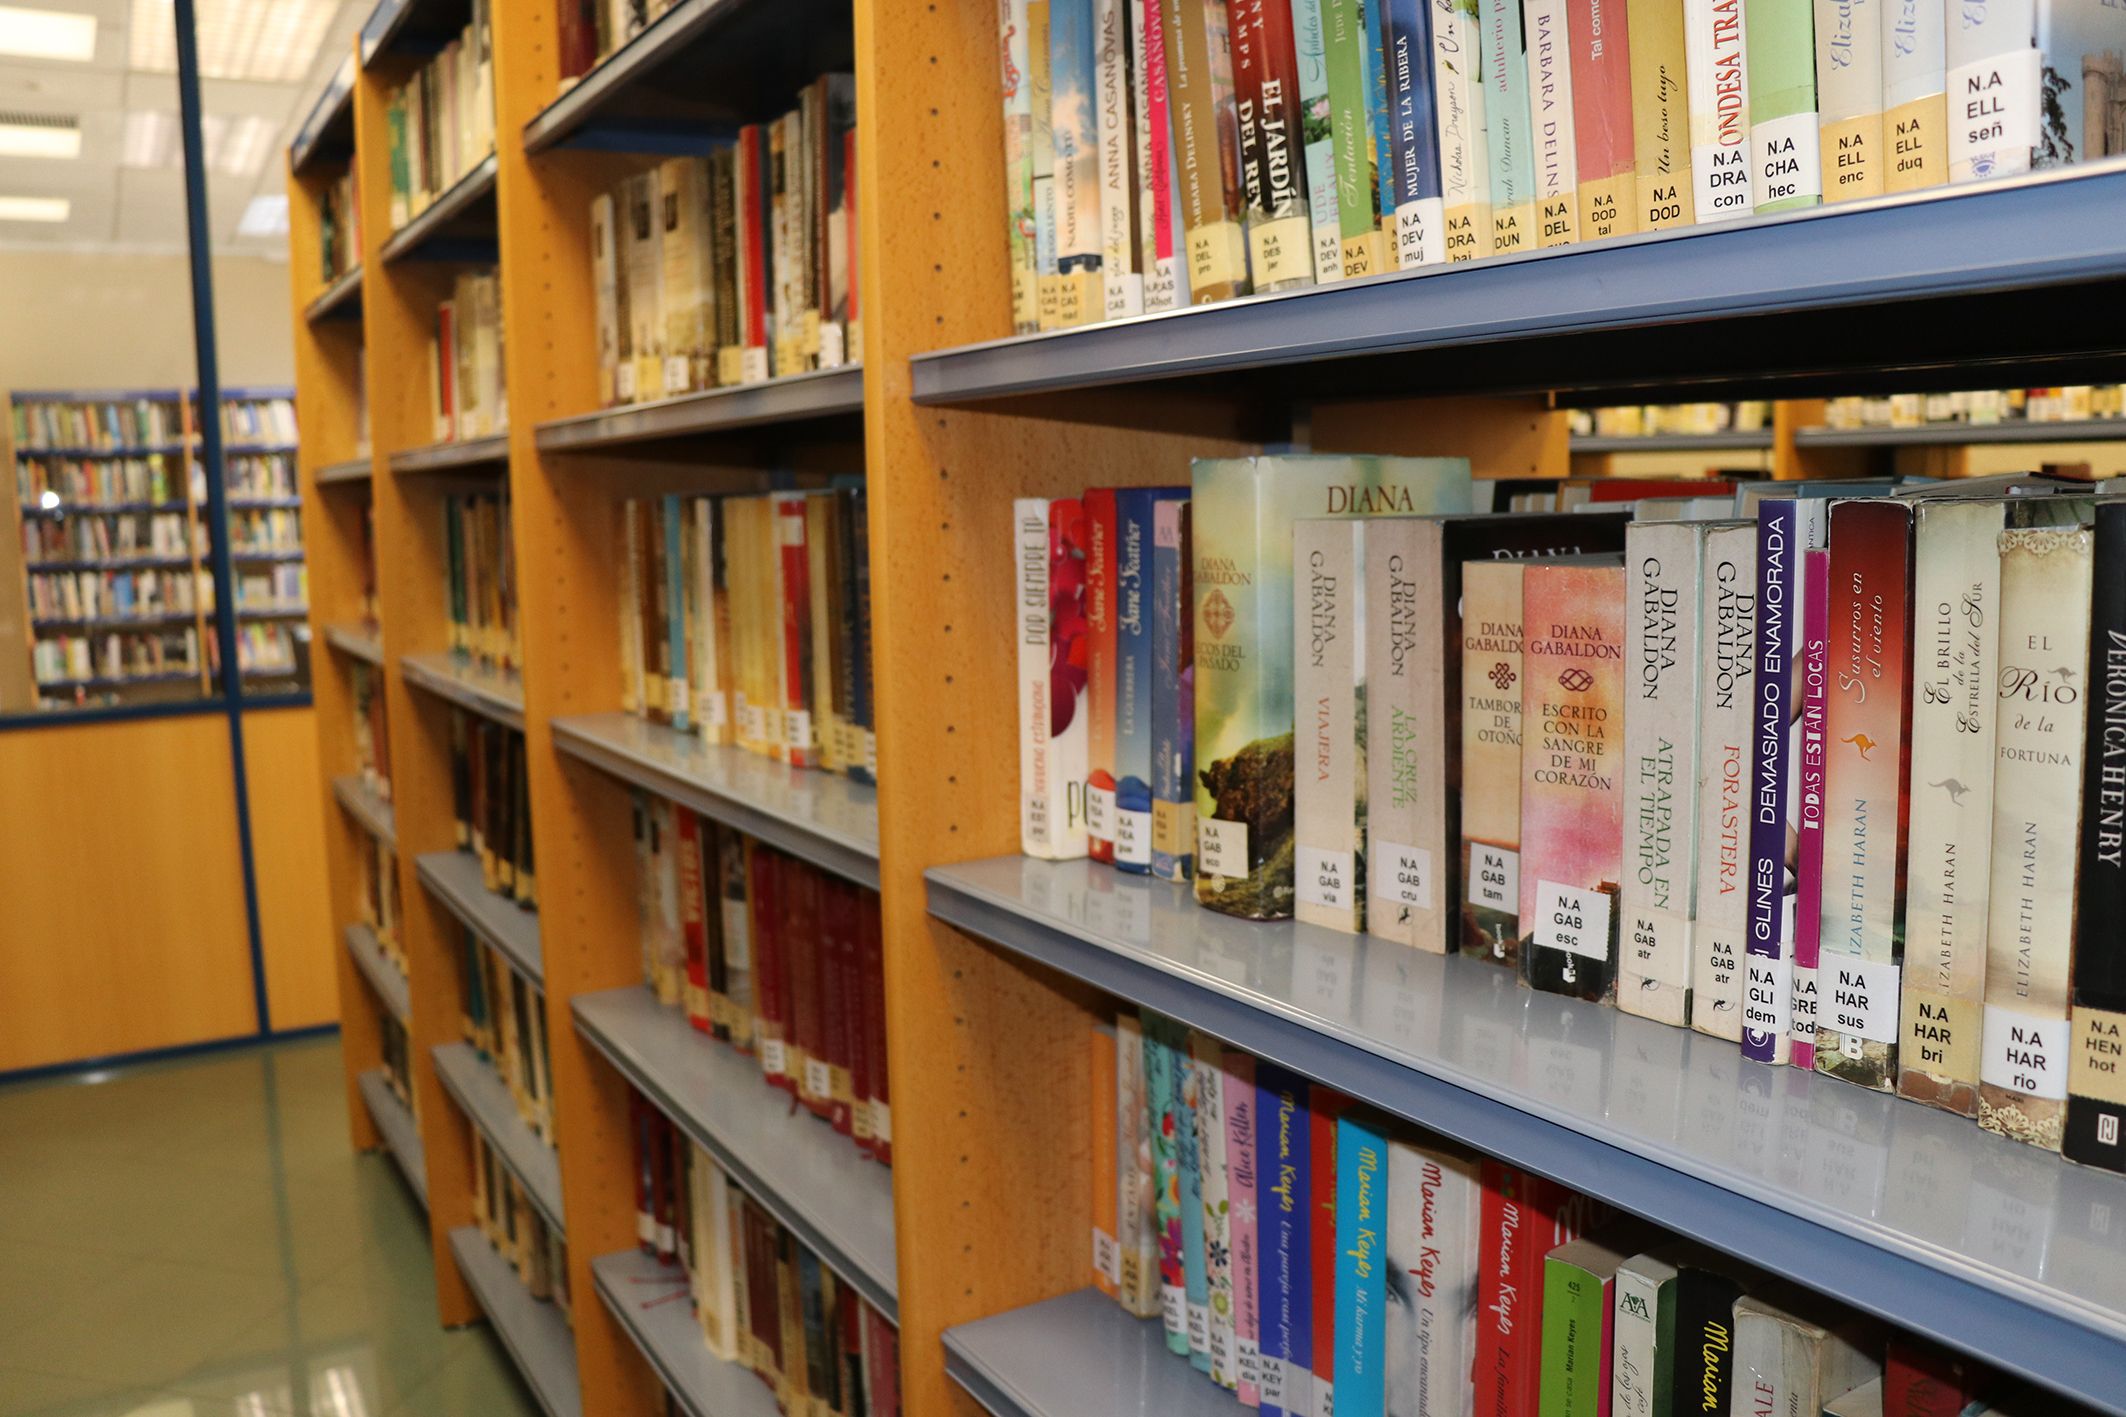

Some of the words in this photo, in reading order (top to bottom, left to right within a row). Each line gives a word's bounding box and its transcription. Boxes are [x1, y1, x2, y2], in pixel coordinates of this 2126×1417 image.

[1591, 41, 1604, 62] Tal
[1103, 10, 1119, 130] CASANOVAS
[1396, 35, 1411, 93] RIBERA
[1537, 14, 1557, 113] BARBARA
[1967, 71, 2003, 94] N.A
[1260, 78, 1284, 115] EL
[1401, 96, 1413, 117] LA
[1966, 96, 2006, 120] ELL
[1182, 102, 1197, 170] DELINSKY
[1238, 98, 1257, 156] DEL
[1403, 120, 1414, 142] DE
[1896, 119, 1921, 137] N.A
[1967, 121, 2004, 144] señ
[1767, 137, 1796, 157] N.A
[1838, 134, 1864, 151] N.A
[1895, 137, 1923, 154] ELL
[1107, 134, 1121, 190] ANNA
[1259, 117, 1297, 218] JARDÍN
[1713, 150, 1744, 168] N.A
[1764, 157, 1800, 179] CHA
[1837, 151, 1866, 168] ELL
[1896, 154, 1924, 173] duq
[1404, 145, 1421, 197] MUJER
[1709, 171, 1748, 188] DRA
[1838, 170, 1865, 185] enc
[1243, 158, 1263, 209] REY
[1653, 186, 1677, 202] N.A
[1768, 182, 1796, 199] hec
[1544, 203, 1568, 219] N.A
[1594, 194, 1614, 208] N.A
[1713, 193, 1744, 209] con
[1401, 213, 1421, 228] N.A
[1592, 208, 1618, 223] DOD
[1650, 204, 1681, 222] DOD
[1448, 216, 1471, 232] N.A
[1495, 216, 1517, 232] N.A
[1544, 221, 1571, 237] DEL
[1598, 224, 1612, 236] tal
[1401, 228, 1425, 246] DEV
[1447, 232, 1476, 249] DRA
[1495, 232, 1521, 250] DUN
[1344, 245, 1366, 260] N.A
[1403, 247, 1425, 264] muj
[1344, 260, 1369, 277] DEV
[1326, 485, 1416, 514] DIANA
[1852, 571, 1863, 595] en
[1764, 516, 1785, 674] ENAMORADA
[1309, 550, 1325, 669] GABALDON
[1323, 575, 1338, 644] DIANA
[1388, 554, 1404, 678] GABALDON
[1402, 582, 1417, 652] DIANA
[1551, 624, 1603, 641] DIANA
[1642, 557, 1661, 701] GABALDON
[1660, 588, 1679, 672] DIANA
[1867, 594, 1884, 656] viento
[1936, 601, 1952, 670] BRILLO
[1716, 561, 1737, 711] GABALDON
[1735, 593, 1756, 681] DIANA
[1967, 631, 1982, 658] del
[2027, 635, 2054, 651] EL
[1530, 640, 1622, 660] GABALDON
[1838, 598, 1867, 705] Susurros
[1952, 651, 1966, 668] la
[1807, 640, 1824, 699] LOCAS
[1865, 657, 1881, 679] el
[1952, 669, 1966, 686] de
[2101, 629, 2126, 758] VERONICA
[1493, 715, 1511, 729] DE
[1542, 703, 1608, 722] ESCRITO
[1404, 714, 1417, 743] LA
[1542, 720, 1580, 738] CON
[1586, 723, 1605, 739] LA
[2013, 714, 2032, 731] de
[2037, 714, 2054, 734] la
[1316, 697, 1330, 782] VIAJERA
[1542, 736, 1605, 756] SANGRE
[1804, 705, 1823, 767] ESTÁN
[1391, 704, 1405, 810] ARDIENTE
[1550, 754, 1573, 769] DE
[1578, 757, 1597, 772] MI
[1760, 682, 1781, 825] DEMASIADO
[2000, 746, 2072, 767] FORTUNA
[1405, 747, 1418, 804] CRUZ
[1534, 769, 1613, 791] CORAZÓN
[1640, 756, 1656, 785] EL
[1655, 736, 1674, 869] ATRAPADA
[1804, 772, 1821, 830] TODAS
[1719, 745, 1741, 896] FORASTERA
[2097, 766, 2126, 869] HENRY
[1638, 792, 1656, 886] TIEMPO
[1852, 798, 1868, 867] HARAN
[1399, 856, 1419, 871] N.A
[1484, 854, 1504, 869] N.A
[2022, 821, 2038, 888] HARAN
[1320, 861, 1339, 874] N.A
[1942, 843, 1957, 905] HARAN
[1318, 876, 1342, 890] GAB
[1397, 871, 1422, 887] GAB
[1481, 870, 1507, 887] GAB
[1322, 891, 1337, 904] via
[1400, 889, 1418, 903] cru
[1482, 887, 1503, 903] tam
[1557, 896, 1582, 912] N.A
[1654, 877, 1670, 911] EN
[1755, 858, 1775, 941] GLINES
[1553, 912, 1584, 930] GAB
[1637, 919, 1655, 934] N.A
[1555, 931, 1579, 946] esc
[1634, 932, 1657, 948] GAB
[1713, 941, 1733, 956] N.A
[2016, 897, 2034, 998] ELIZABETH
[1638, 949, 1652, 960] atr
[1710, 956, 1736, 971] GAB
[1715, 974, 1731, 985] atr
[1749, 968, 1775, 986] N.A
[1838, 970, 1867, 990] N.A
[1749, 988, 1775, 1005] GLI
[1834, 989, 1870, 1011] HAR
[1746, 1007, 1777, 1025] dem
[1836, 1013, 1865, 1030] sus
[1918, 1003, 1950, 1024] N.A
[1913, 1023, 1952, 1046] HAR
[2010, 1025, 2044, 1049] N.A
[2090, 1020, 2120, 1038] N.A
[1920, 1045, 1944, 1065] bri
[2085, 1038, 2123, 1056] HEN
[2006, 1047, 2047, 1072] HAR
[2088, 1056, 2117, 1074] hot
[2012, 1073, 2037, 1092] rio
[1278, 1091, 1296, 1161] Marian
[1271, 1162, 1298, 1214] Keyes
[1357, 1146, 1377, 1222] Marian
[1421, 1161, 1443, 1241] Marian
[1498, 1202, 1519, 1277] Marian
[1346, 1226, 1377, 1279] Keyes
[1408, 1246, 1441, 1299] Keyes
[1419, 1307, 1434, 1328] Un
[1488, 1282, 1518, 1336] Keyes
[1567, 1318, 1577, 1341] Keyes
[1263, 1359, 1281, 1372] N.A
[1566, 1340, 1577, 1372] Marian
[1701, 1320, 1729, 1413] Marian
[1261, 1371, 1283, 1385] KEY
